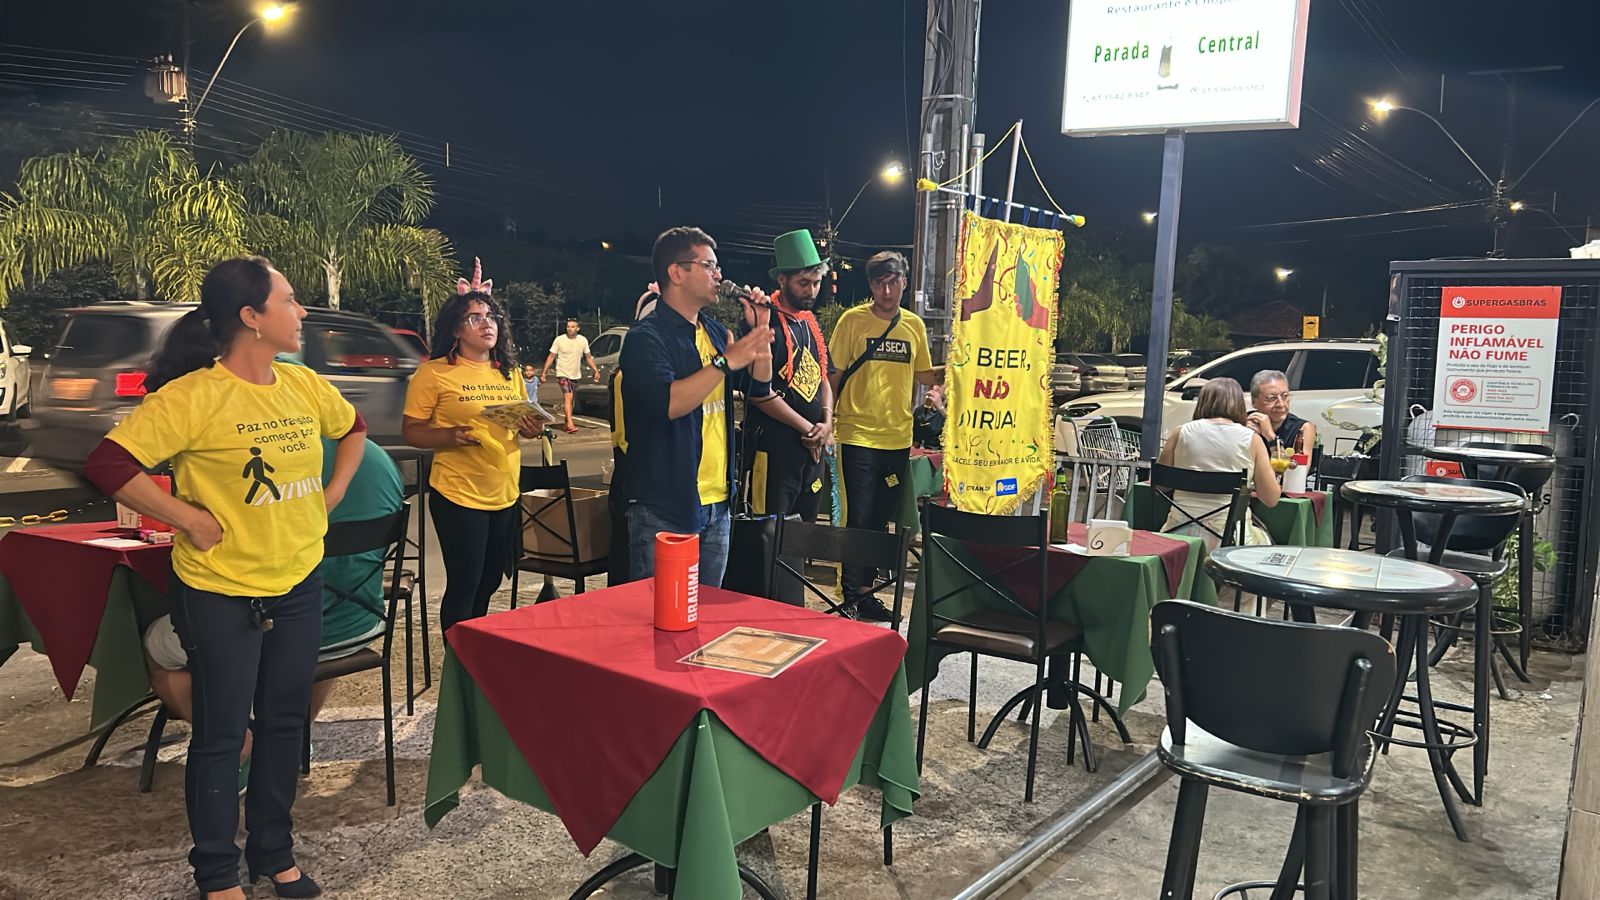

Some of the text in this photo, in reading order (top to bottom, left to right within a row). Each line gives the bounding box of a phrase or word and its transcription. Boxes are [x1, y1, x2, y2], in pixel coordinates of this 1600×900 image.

[1107, 1, 1181, 15] Restaurante
[1198, 30, 1260, 54] Central
[1094, 40, 1149, 63] Parada
[1466, 299, 1547, 307] SUPERGASBRAS
[1451, 324, 1505, 335] PERIGO
[885, 341, 908, 354] SECA
[1450, 335, 1544, 349] INFLAMÁVEL
[1449, 348, 1528, 361] NÃO FUME
[458, 393, 495, 402] escolha
[236, 423, 262, 435] Paz
[262, 420, 278, 430] no
[254, 430, 299, 444] começa
[279, 440, 311, 454] você.
[687, 562, 699, 623] BRAHMA
